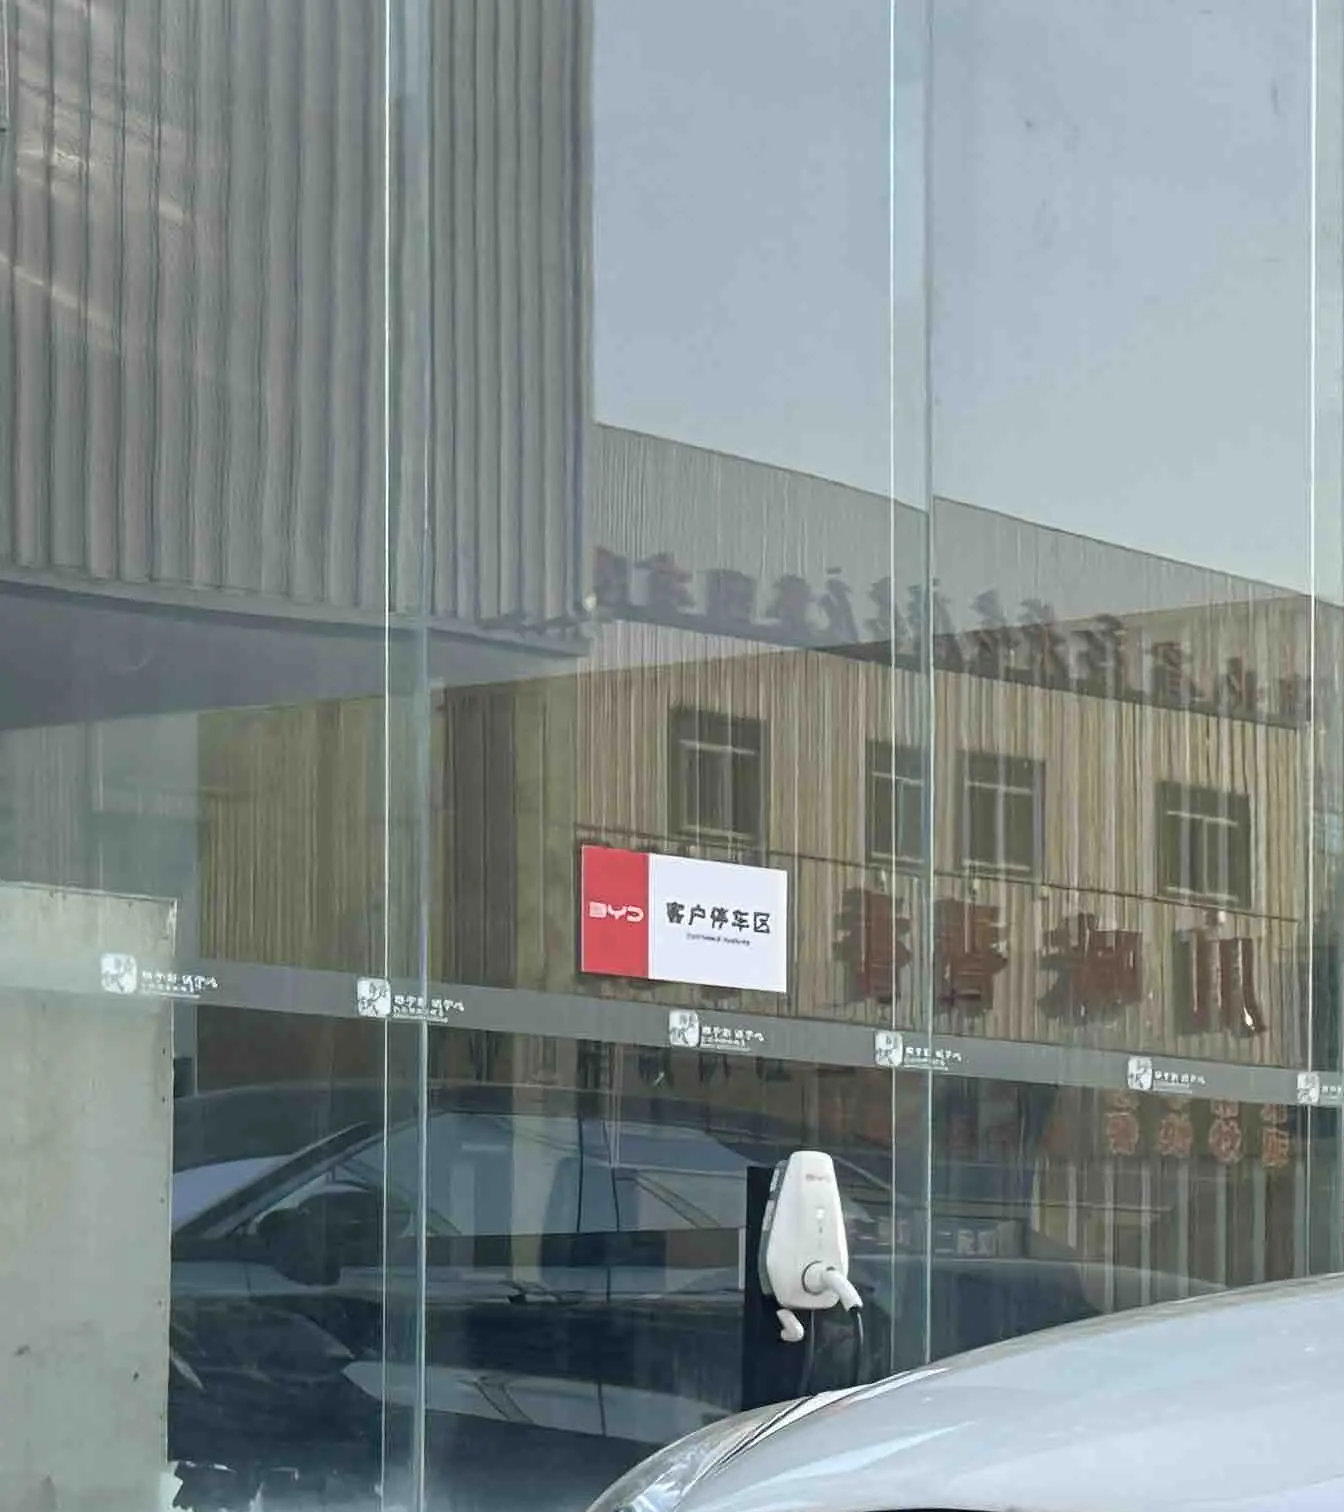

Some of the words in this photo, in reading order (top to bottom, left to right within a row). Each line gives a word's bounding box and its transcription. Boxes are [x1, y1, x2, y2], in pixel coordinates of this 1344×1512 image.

[589, 902, 644, 922] BYD
[666, 901, 770, 933] 客户停车区
